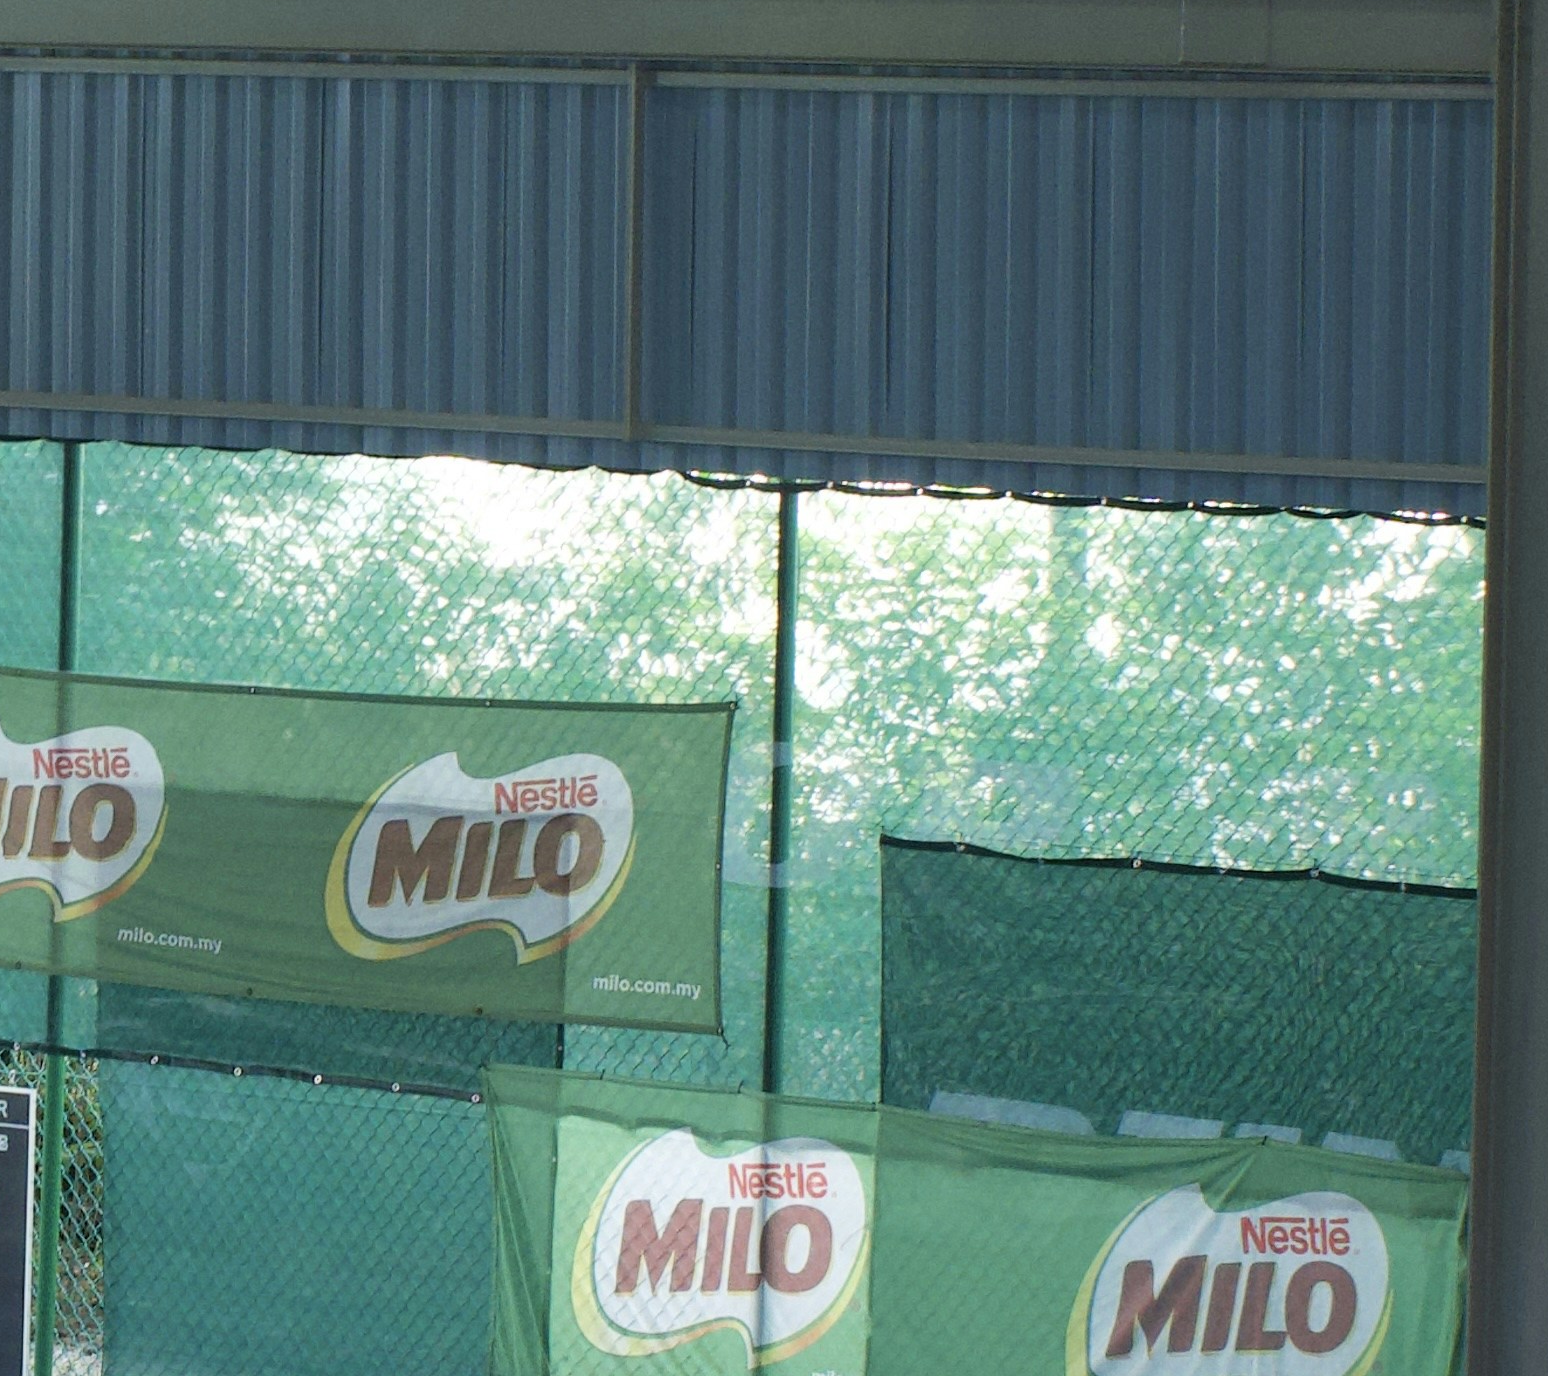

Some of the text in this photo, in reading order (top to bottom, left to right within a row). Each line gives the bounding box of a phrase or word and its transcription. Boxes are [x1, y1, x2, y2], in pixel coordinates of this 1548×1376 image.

[33, 746, 130, 781] Nestlé
[494, 775, 599, 814] Nestlé
[367, 812, 606, 910] MILO
[116, 925, 223, 955] milo.com.my
[592, 973, 702, 1000] milo.com.my
[728, 1161, 829, 1200] Nestlé
[615, 1198, 832, 1296] MILO
[1240, 1215, 1350, 1256] Nestlé
[1105, 1254, 1356, 1361] MILO
